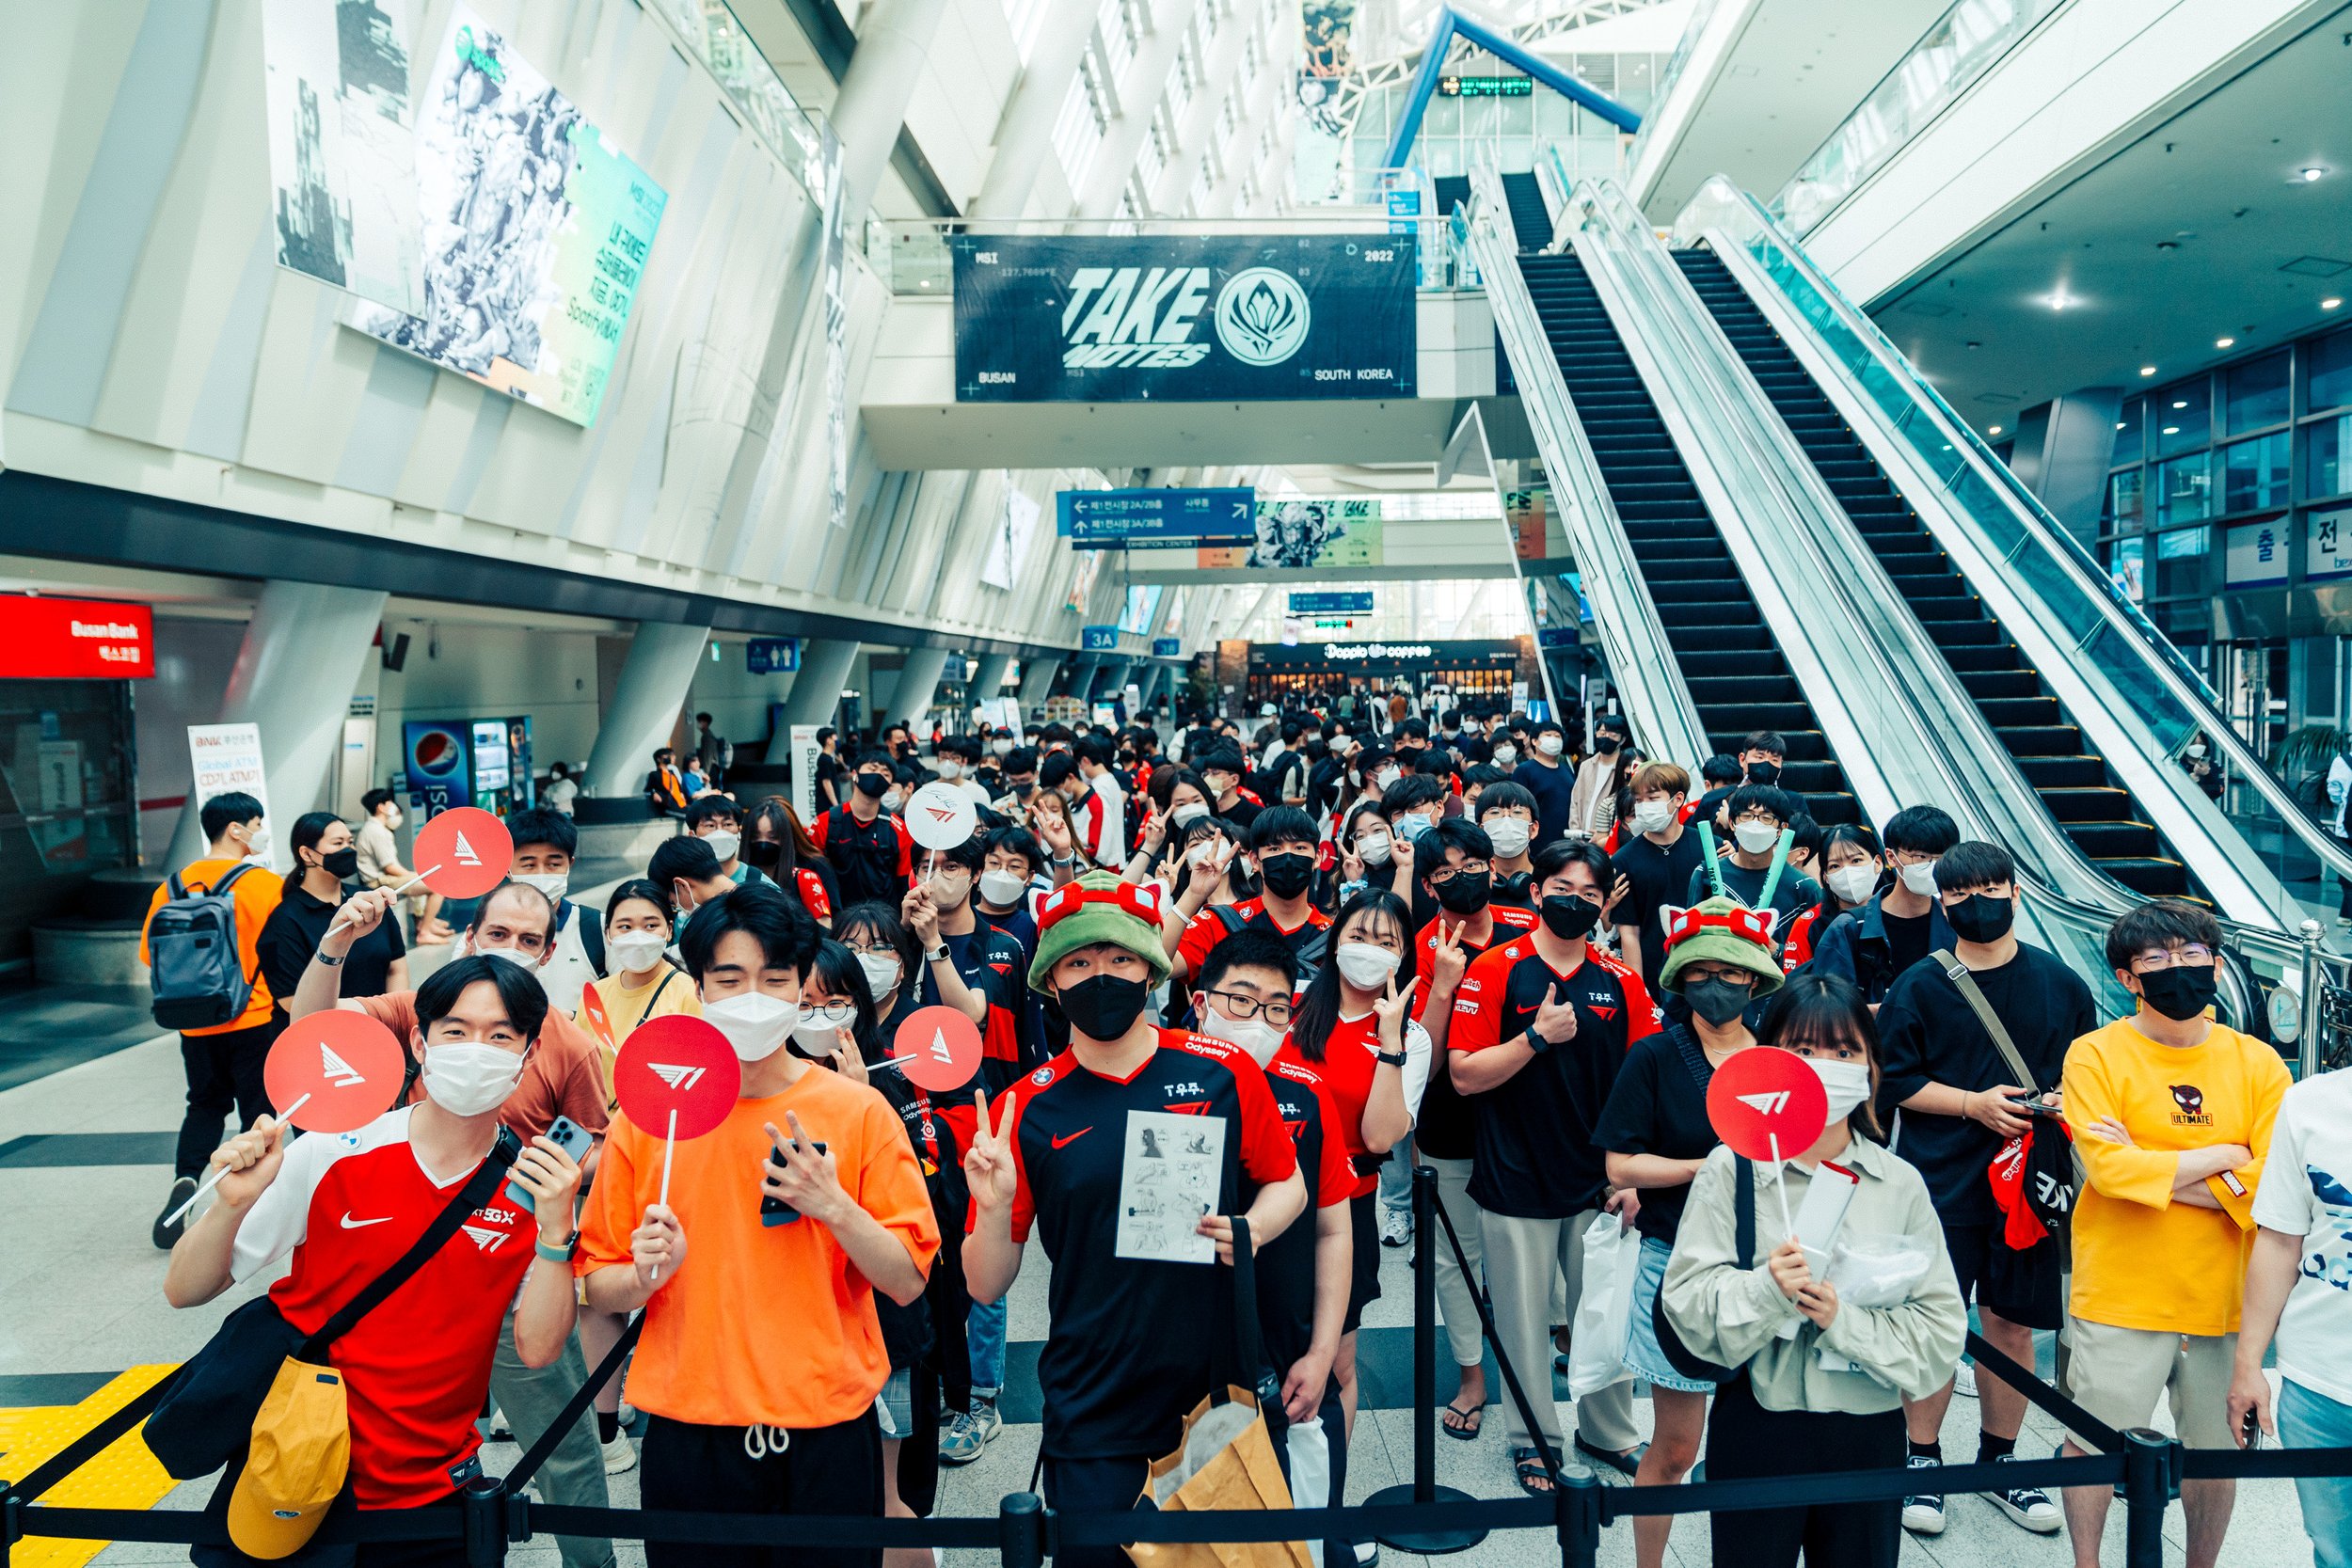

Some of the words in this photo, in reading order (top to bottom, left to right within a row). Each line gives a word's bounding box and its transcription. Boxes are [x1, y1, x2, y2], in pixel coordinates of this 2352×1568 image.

[976, 252, 998, 264] MSI
[1365, 250, 1393, 261] 2022
[1062, 267, 1211, 344] TAKE
[1062, 343, 1211, 368] NOTES
[978, 372, 1016, 384] BUSAN
[1314, 370, 1351, 380] SOUTH
[1357, 369, 1393, 379] KOREA
[71, 620, 107, 638] Busan
[108, 623, 139, 640] Bank
[1092, 633, 1113, 647] 3A
[1185, 1041, 1231, 1059] Odyssey
[1188, 1035, 1240, 1053] SAMSUNG
[1279, 1068, 1318, 1084] Odyssey
[2173, 1115, 2211, 1125] ULTIMATE
